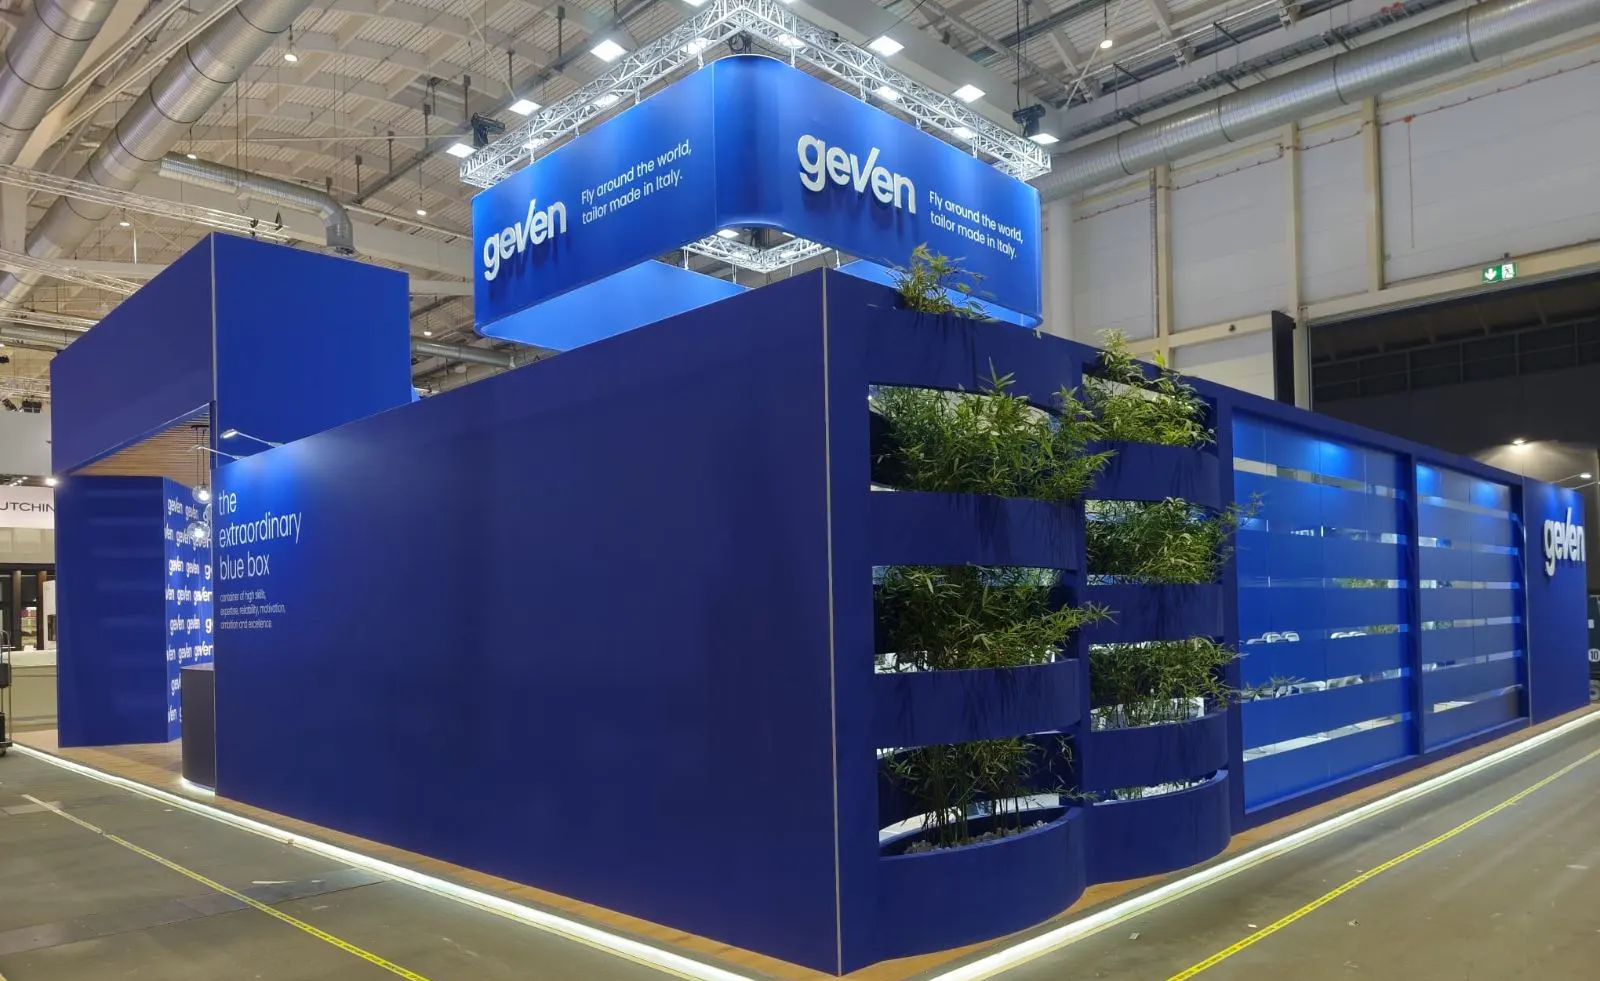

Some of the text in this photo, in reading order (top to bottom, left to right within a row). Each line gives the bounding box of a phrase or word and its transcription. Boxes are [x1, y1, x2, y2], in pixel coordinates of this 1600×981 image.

[581, 139, 692, 206] Fly around the world,
[582, 168, 683, 225] tailor made in Italy.
[798, 134, 916, 215] geven
[483, 198, 567, 281] geven
[929, 190, 1024, 245] Fly around the world,
[930, 210, 1017, 261] tailor made in Italy.
[218, 489, 237, 516] the
[219, 511, 302, 549] extraordinary
[1543, 506, 1586, 577] geven
[219, 553, 245, 581] blue
[247, 549, 270, 578] box
[244, 591, 255, 604] high
[238, 618, 248, 629] and
[1590, 650, 1599, 658] 10
